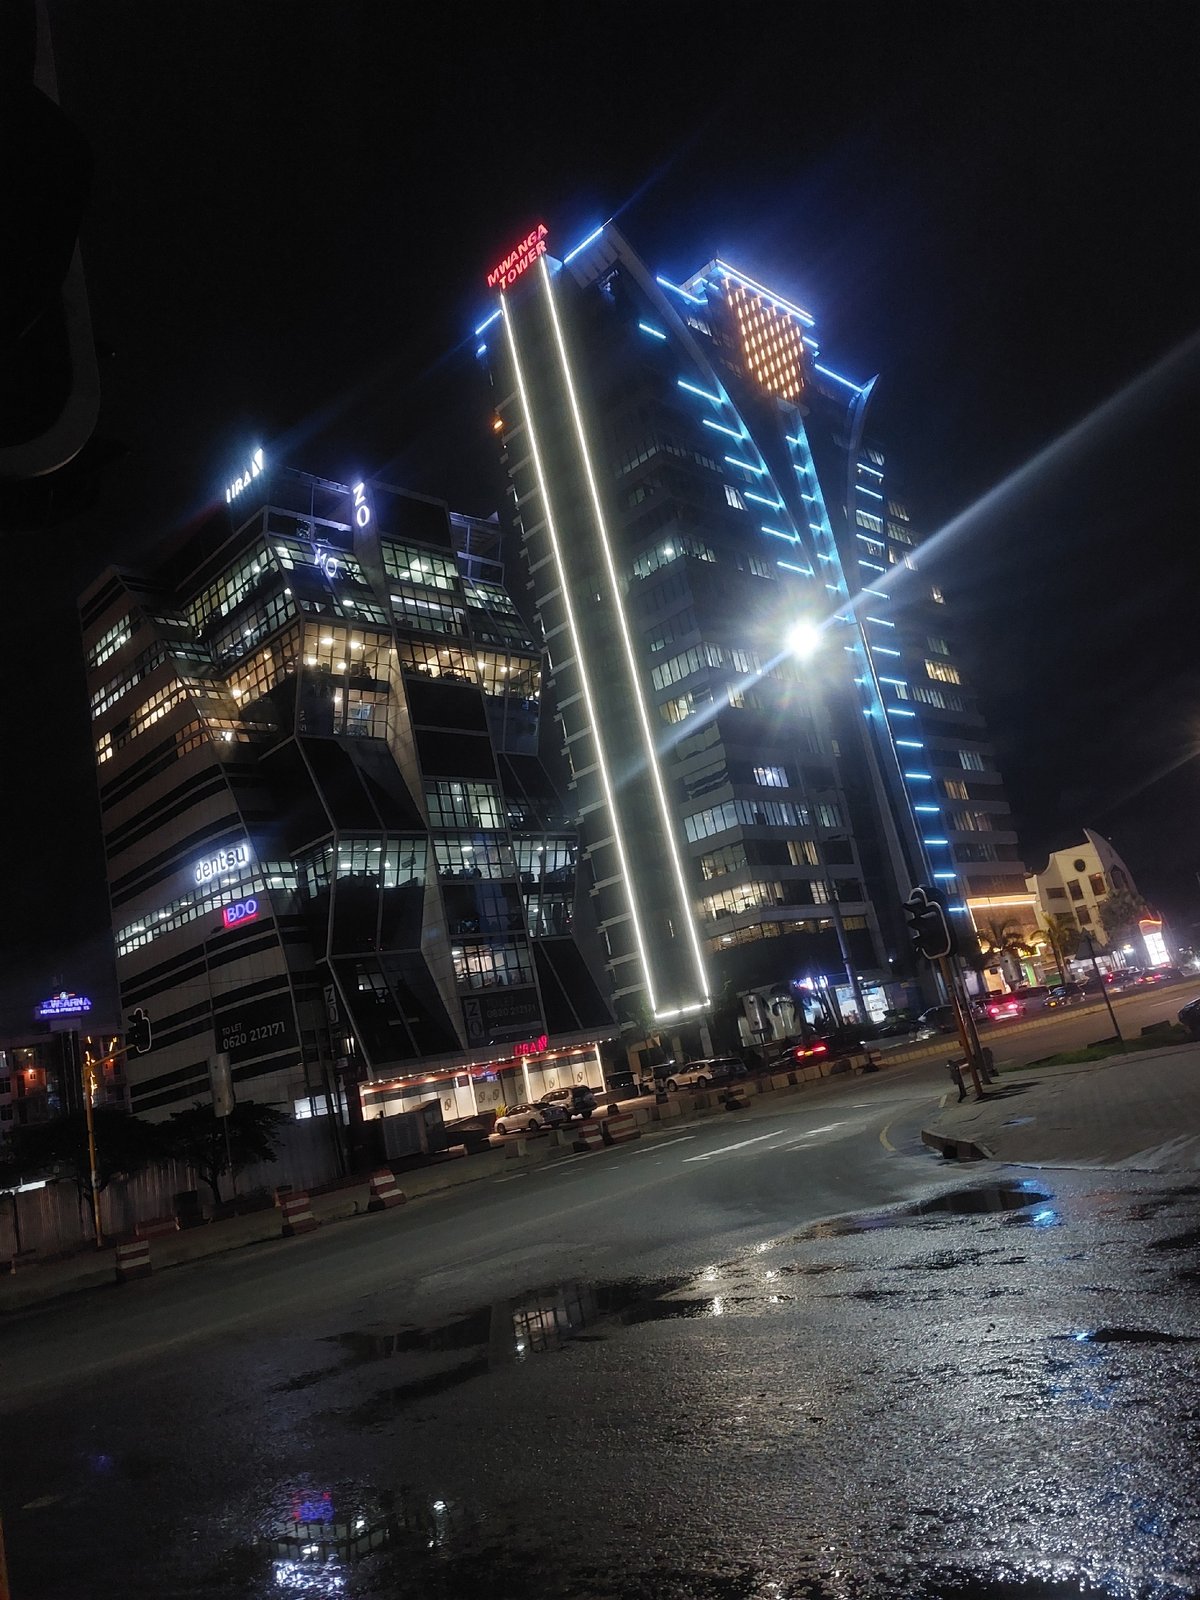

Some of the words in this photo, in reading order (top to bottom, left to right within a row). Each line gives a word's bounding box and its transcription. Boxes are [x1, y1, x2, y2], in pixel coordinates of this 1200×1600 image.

[487, 224, 548, 287] MWANGA
[499, 240, 547, 290] TOWER
[195, 846, 247, 883] dentsu
[227, 899, 257, 922] BDO
[222, 1026, 231, 1036] TO
[231, 1022, 242, 1033] LET
[222, 1033, 247, 1050] 0620
[250, 1021, 285, 1042] 212171
